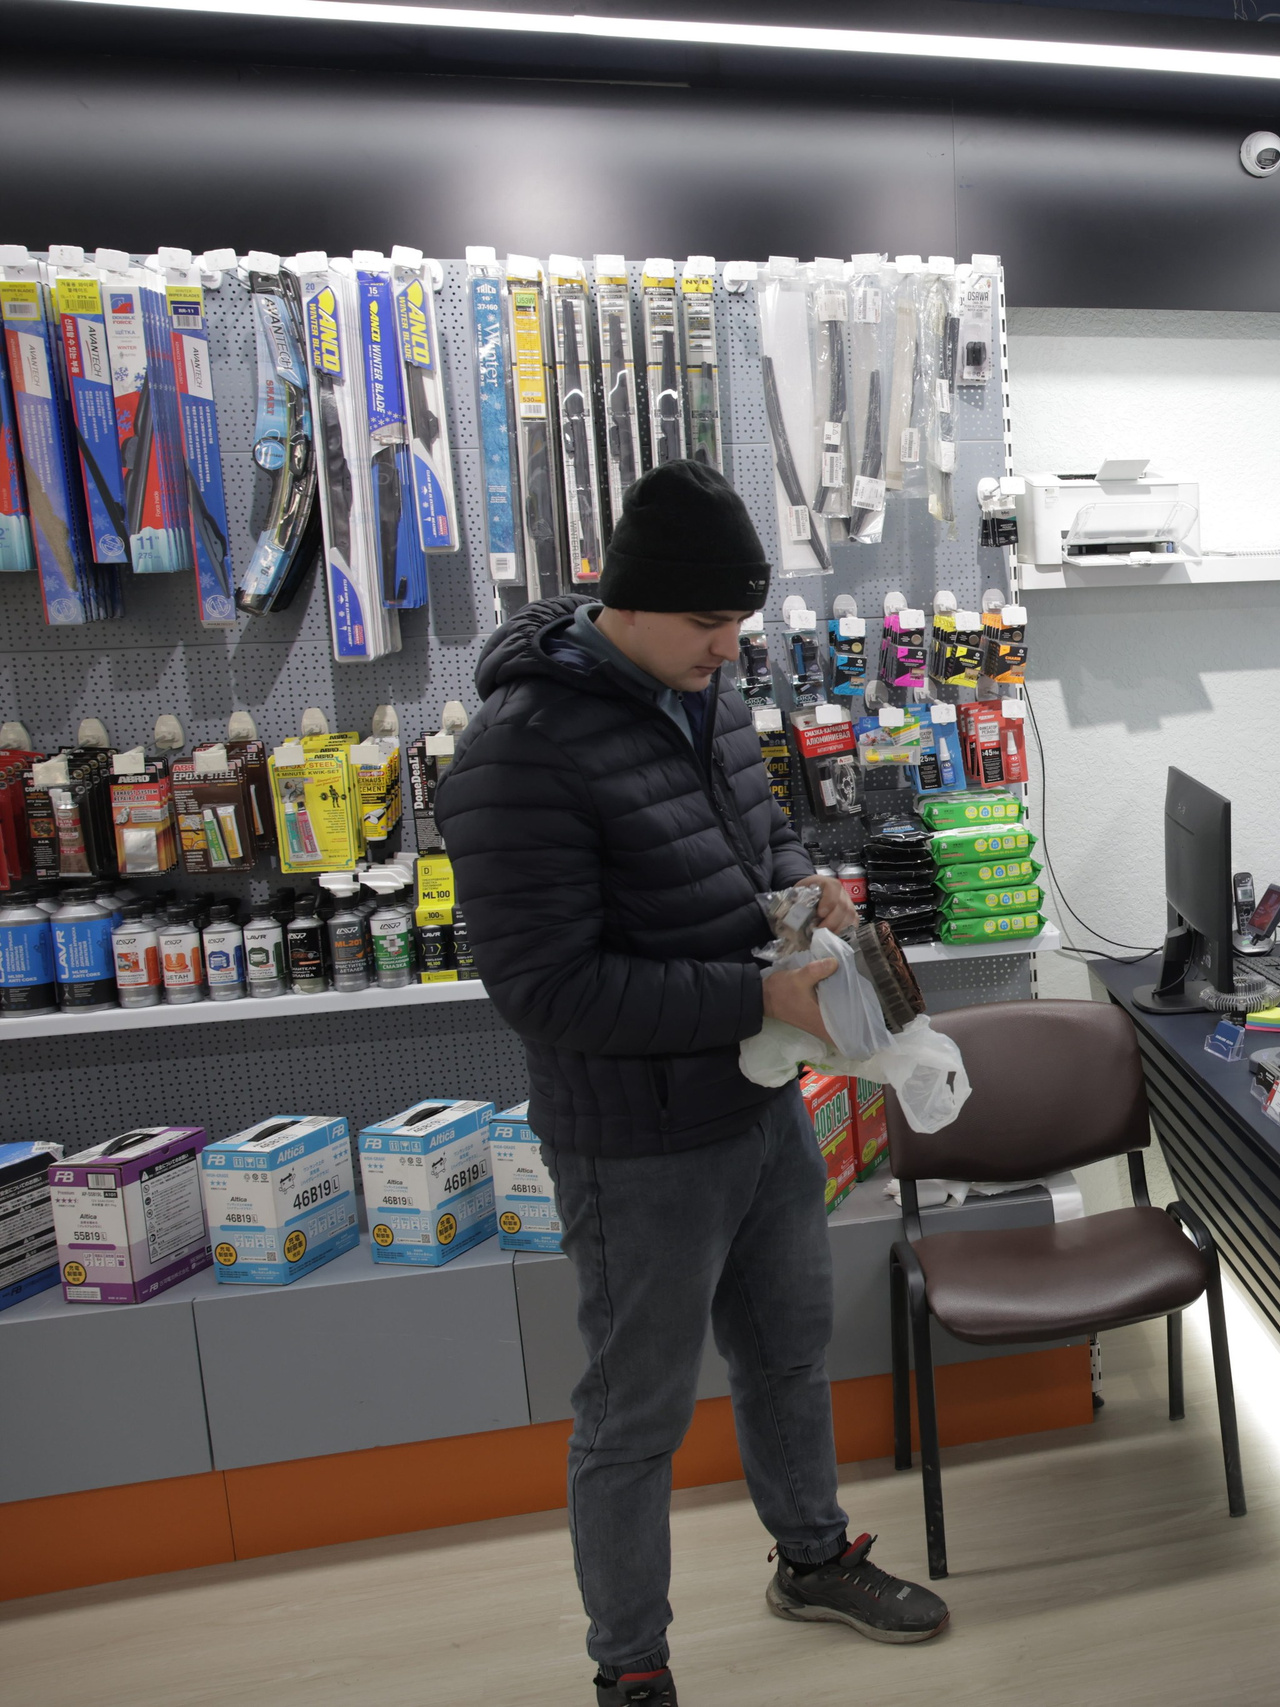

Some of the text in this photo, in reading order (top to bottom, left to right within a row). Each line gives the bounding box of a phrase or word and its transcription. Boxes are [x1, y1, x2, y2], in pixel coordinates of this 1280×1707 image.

[305, 283, 315, 291] 20
[368, 286, 378, 294] 15
[476, 283, 497, 293] TRICO
[967, 291, 989, 301] OSAWA
[477, 303, 498, 311] 37-160
[369, 301, 381, 342] ANCO
[398, 296, 412, 360] WINTER BLADE
[264, 297, 293, 371] AVANTECH
[308, 303, 322, 366] WINTER BLADE
[318, 286, 341, 373] ANCO
[88, 325, 102, 378] AVANTECH
[28, 344, 41, 387] AVANTECH
[192, 347, 203, 389] AVANTECH
[371, 345, 385, 415] WINTER BLADE
[265, 380, 275, 416] SMART
[571, 520, 579, 552] WINTER
[804, 724, 850, 738] СМАЗКА-КАРАНДАШ
[806, 731, 851, 746] АЛЮМИНИЕВАЯ
[172, 764, 195, 772] ABR
[118, 775, 150, 784] ABRO
[173, 771, 237, 781] EPOXY STEEL
[423, 867, 430, 875] D
[422, 890, 451, 899] ML 100
[335, 939, 362, 947] ML201
[56, 930, 69, 979] LAVR
[382, 962, 407, 970] СМАЗКА
[480, 1110, 493, 1124] FB
[332, 1124, 345, 1139] FB
[495, 1127, 513, 1138] FB
[364, 1138, 383, 1149] FB
[430, 1129, 455, 1149] Altica
[207, 1154, 226, 1166] FB
[277, 1144, 305, 1165] Altica
[54, 1171, 75, 1183] FB
[444, 1167, 479, 1194] 46B19
[293, 1179, 331, 1210] 46B19
[511, 1185, 537, 1194] 46B19
[382, 1196, 407, 1206] 46B19
[225, 1213, 251, 1223] 46B19
[74, 1231, 101, 1241] 55B19
